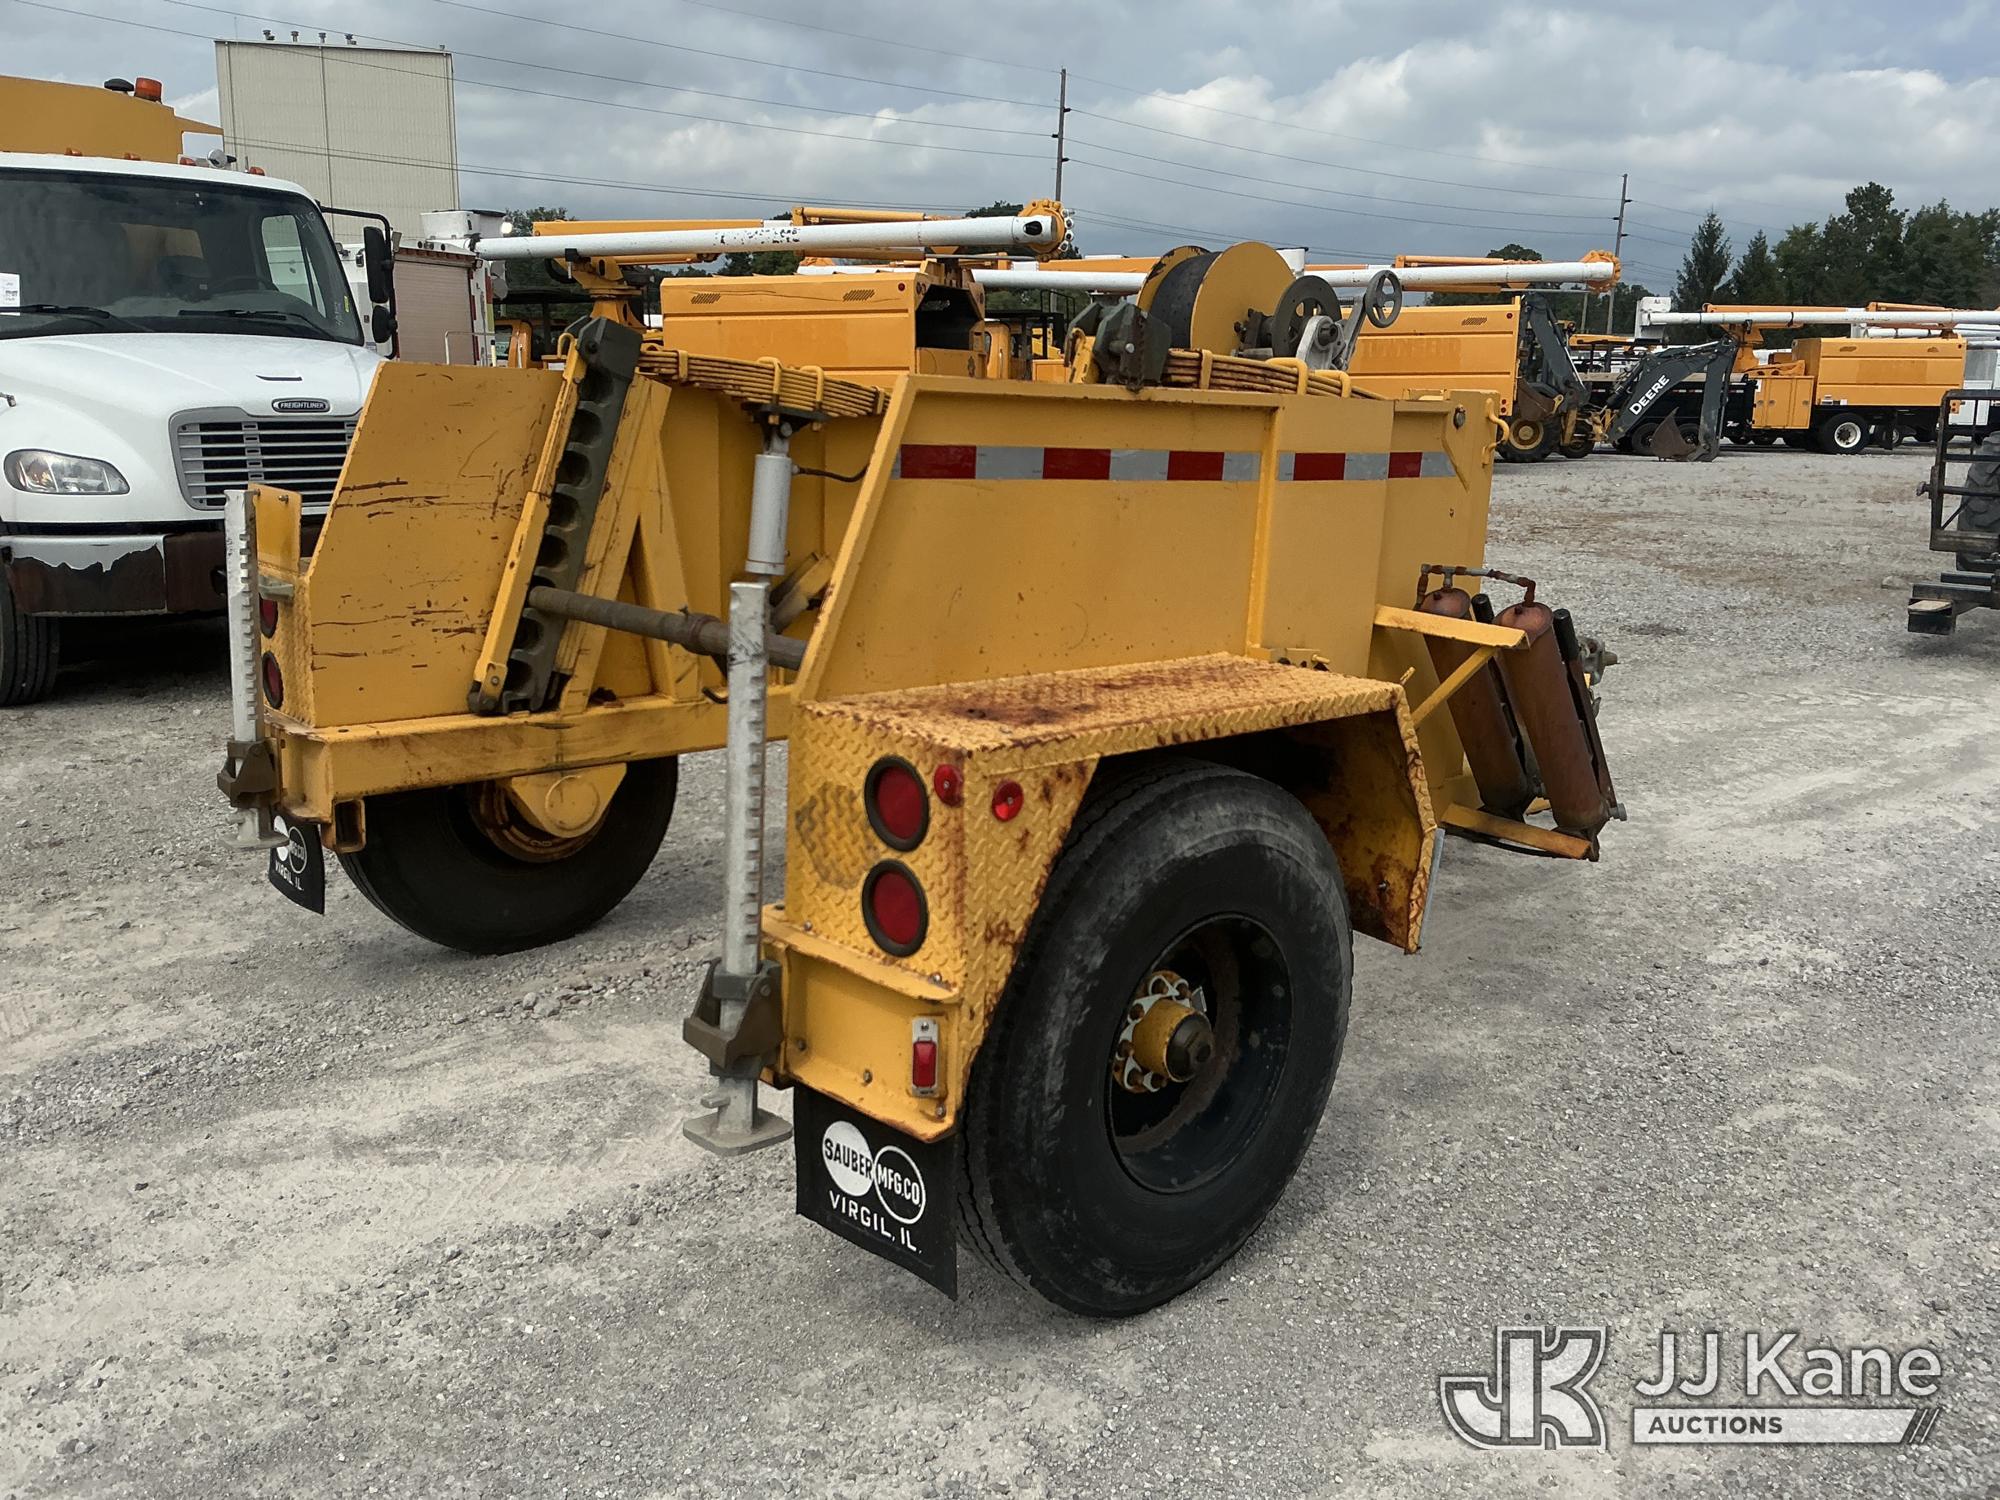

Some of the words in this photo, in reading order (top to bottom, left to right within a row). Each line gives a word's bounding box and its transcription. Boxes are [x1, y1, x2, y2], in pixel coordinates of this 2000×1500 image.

[280, 401, 324, 409] FREIGHTLINER
[1629, 375, 1670, 416] DEERE
[824, 1138, 874, 1181] SAUBER
[829, 1190, 896, 1242] VIRGIL,
